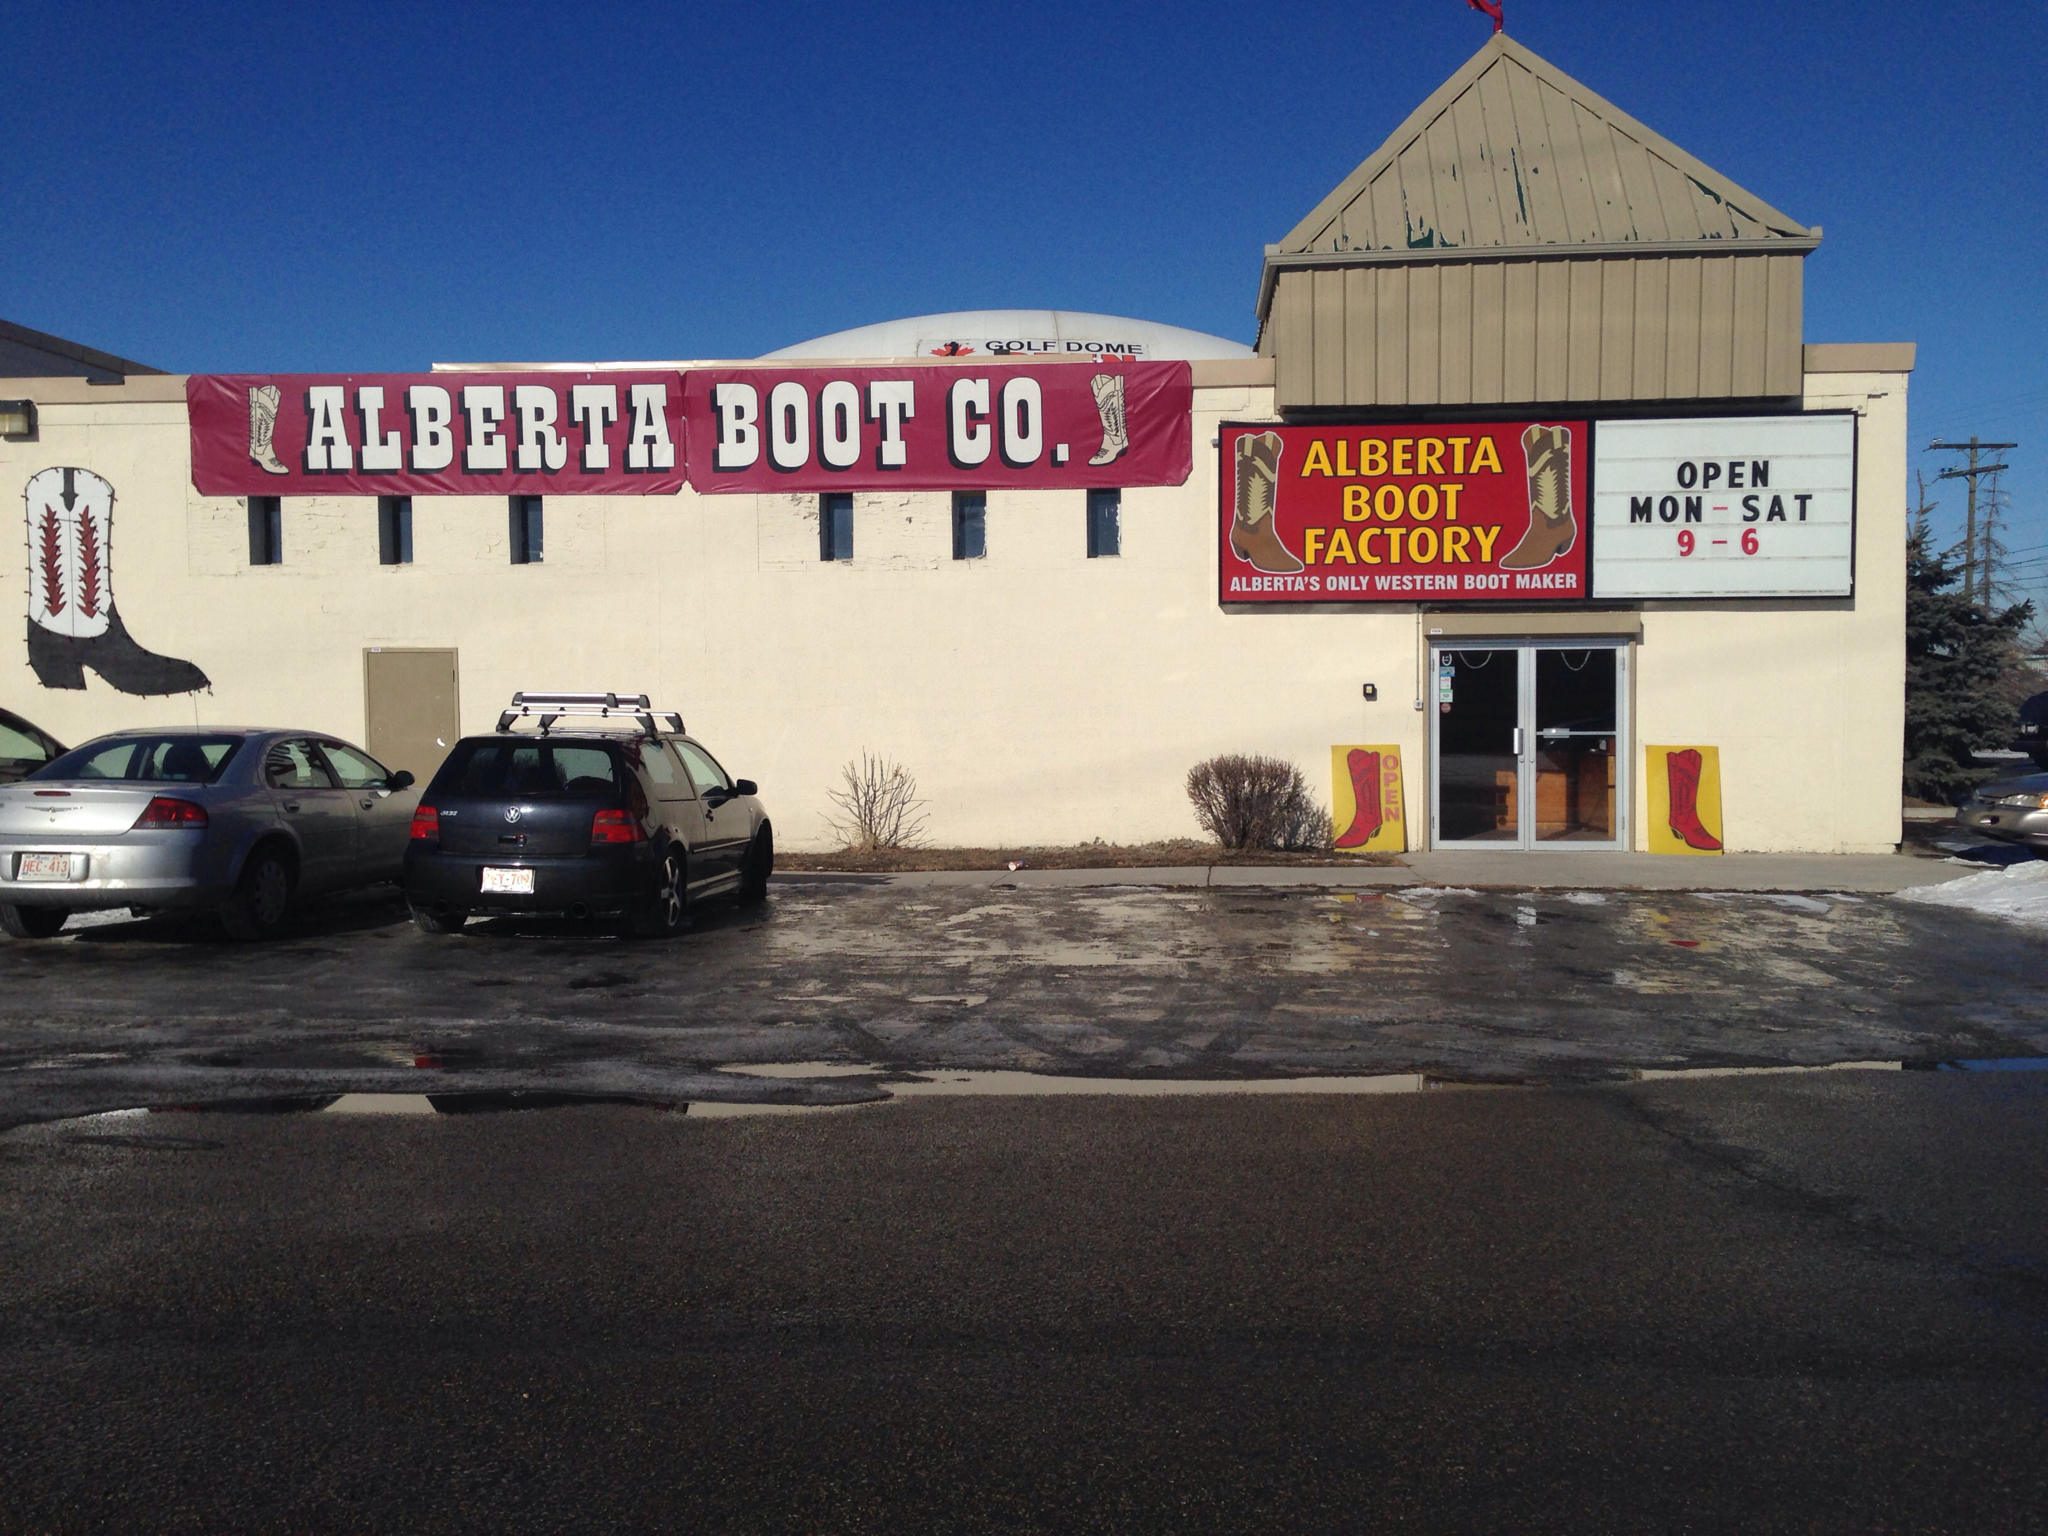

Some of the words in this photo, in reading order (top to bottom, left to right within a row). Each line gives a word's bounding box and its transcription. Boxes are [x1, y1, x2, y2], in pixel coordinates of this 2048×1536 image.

[985, 340, 1057, 351] GOLF
[1066, 341, 1144, 354] DOME
[303, 384, 675, 474] ALBERTA
[711, 380, 916, 472] BOOT
[946, 376, 1070, 470] CO.
[1301, 436, 1504, 477] ALBERTA
[1677, 460, 1769, 489] OPEN
[1343, 483, 1464, 522] BOOT
[1304, 525, 1503, 565] FACTORY
[1230, 576, 1320, 592] ALBERTA'S
[1326, 575, 1369, 591] ONLY
[1375, 575, 1458, 590] WESTERN
[1464, 574, 1510, 589] BOOT
[1516, 573, 1577, 589] MAKER
[1382, 755, 1400, 822] OPEN
[22, 860, 68, 872] HEC-413
